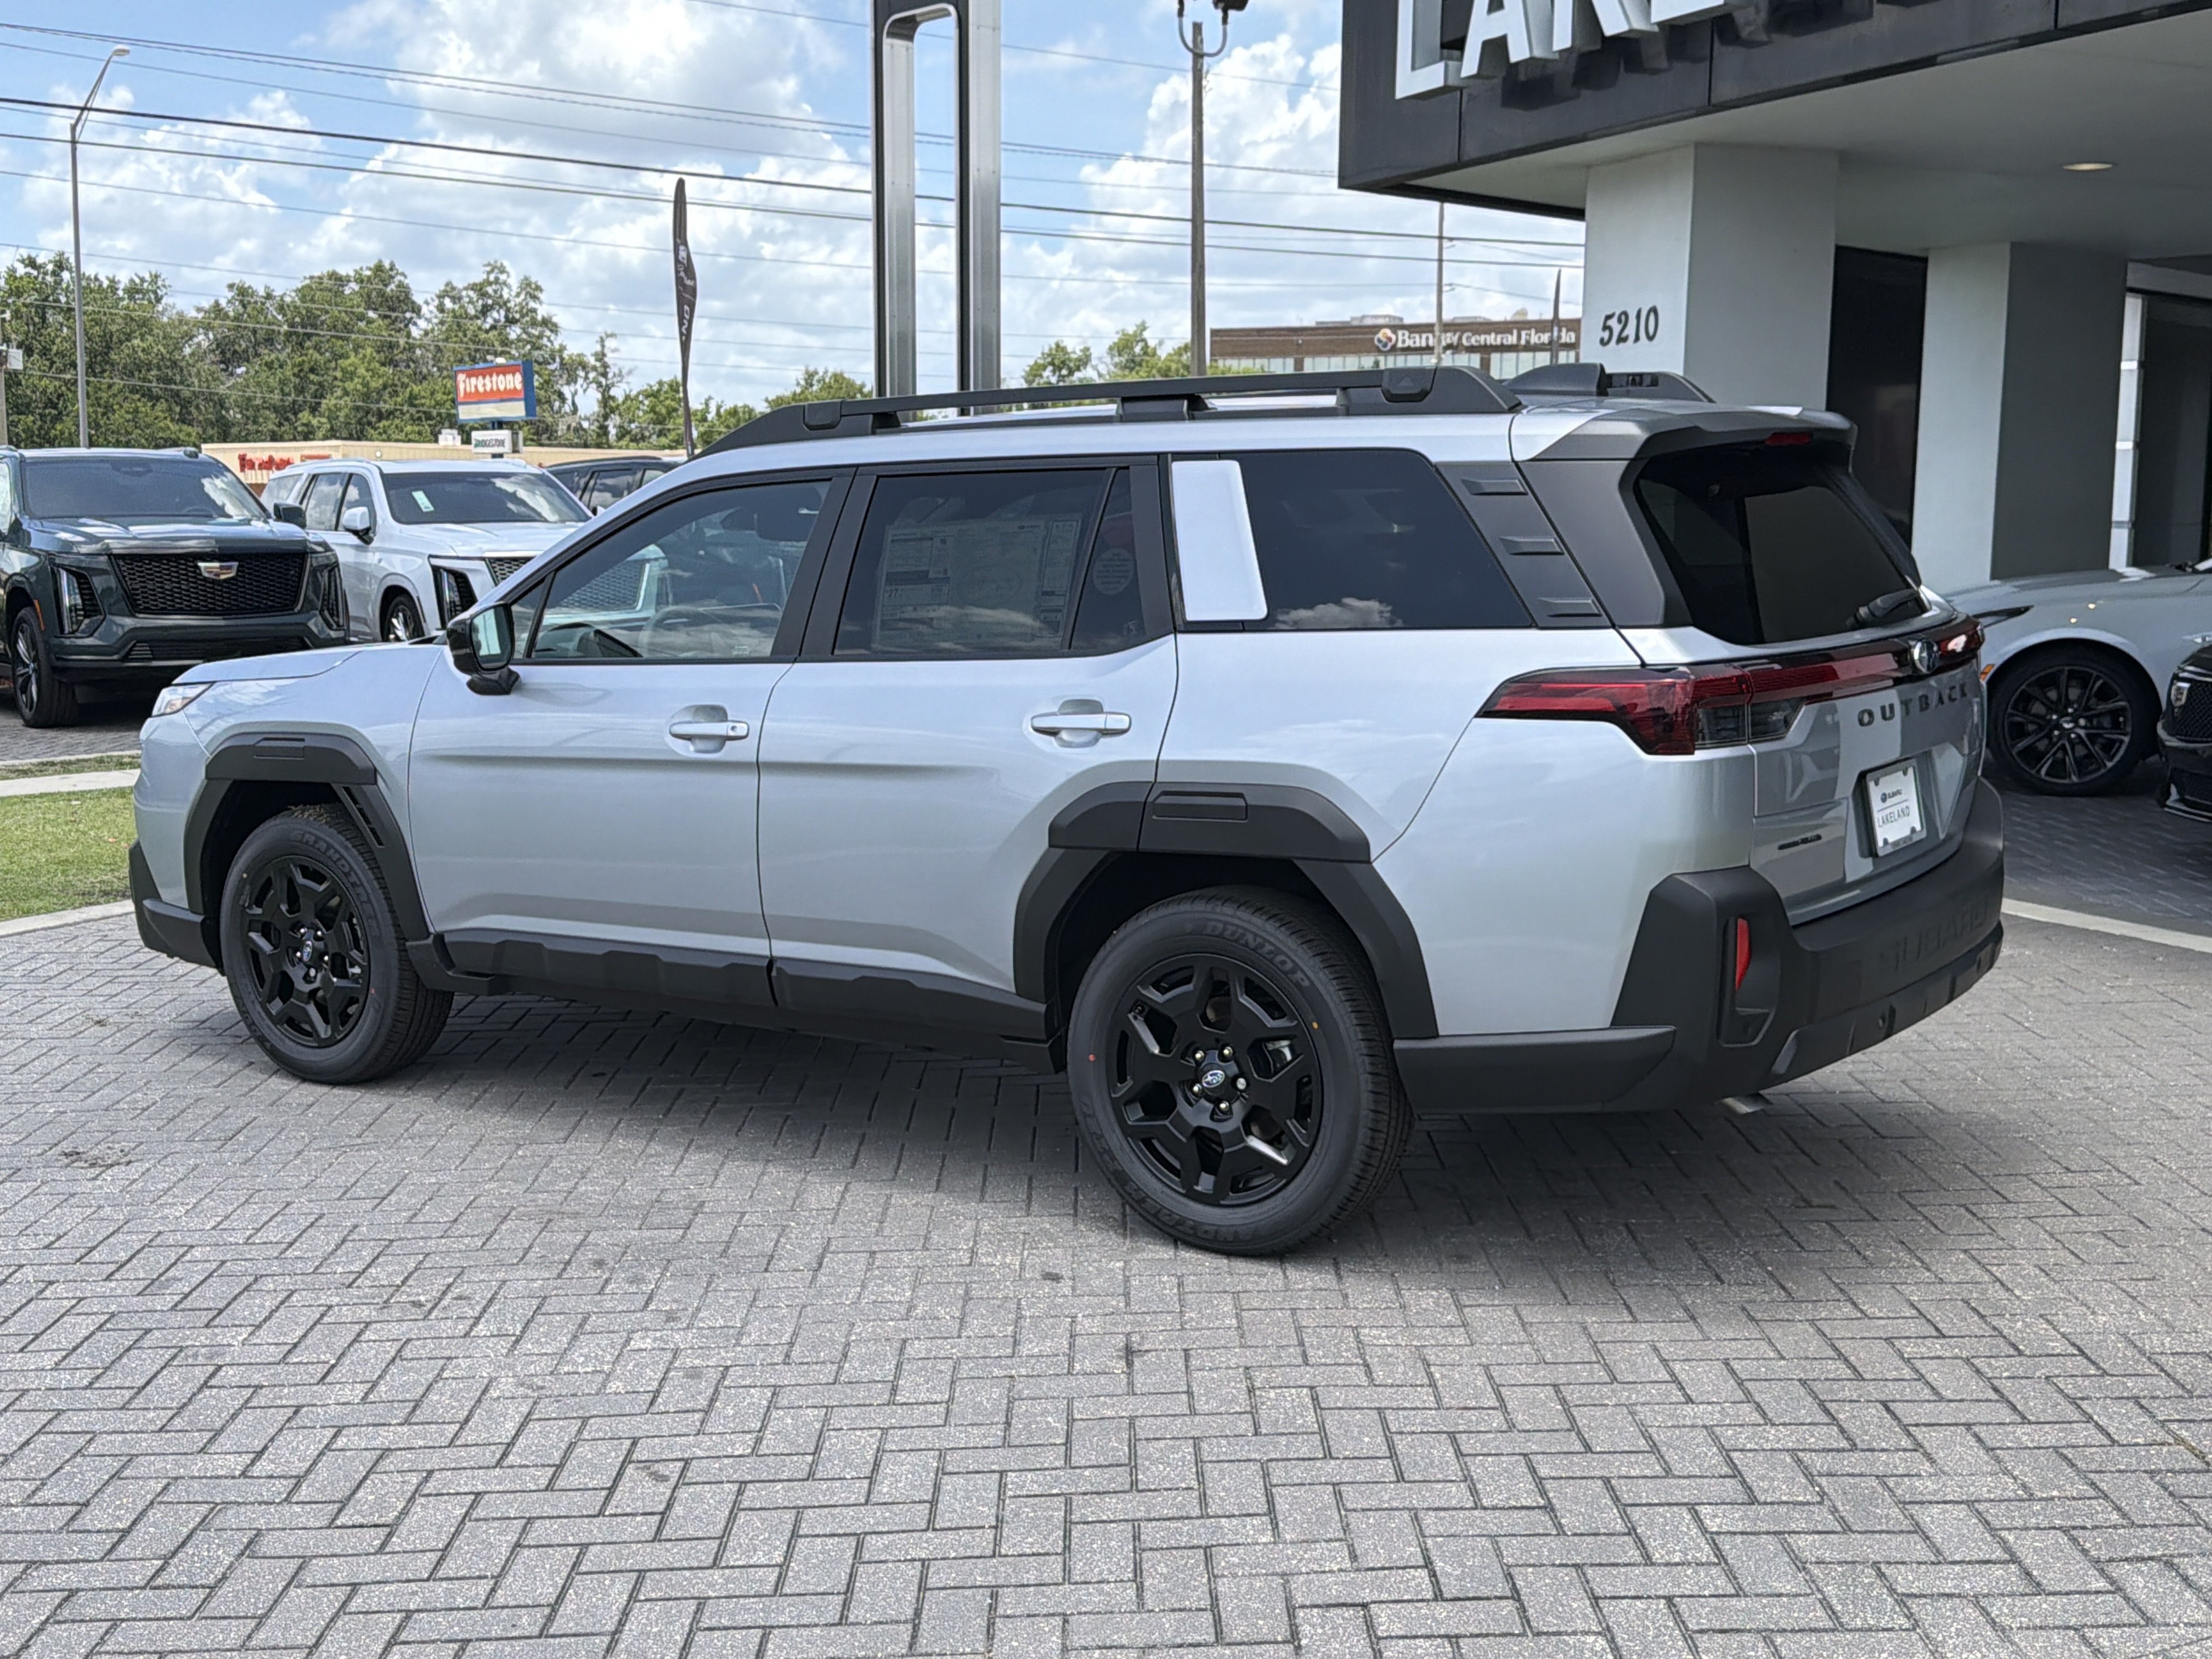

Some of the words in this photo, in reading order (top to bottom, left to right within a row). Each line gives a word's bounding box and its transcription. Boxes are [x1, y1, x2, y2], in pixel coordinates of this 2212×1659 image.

[1462, 329, 1517, 346] Central
[1599, 305, 1659, 347] 5210
[458, 371, 522, 398] Firestone
[1858, 681, 1967, 727] OUTBACK
[1877, 805, 1910, 828] LAKELAND
[1204, 920, 1311, 988] DUNLOP
